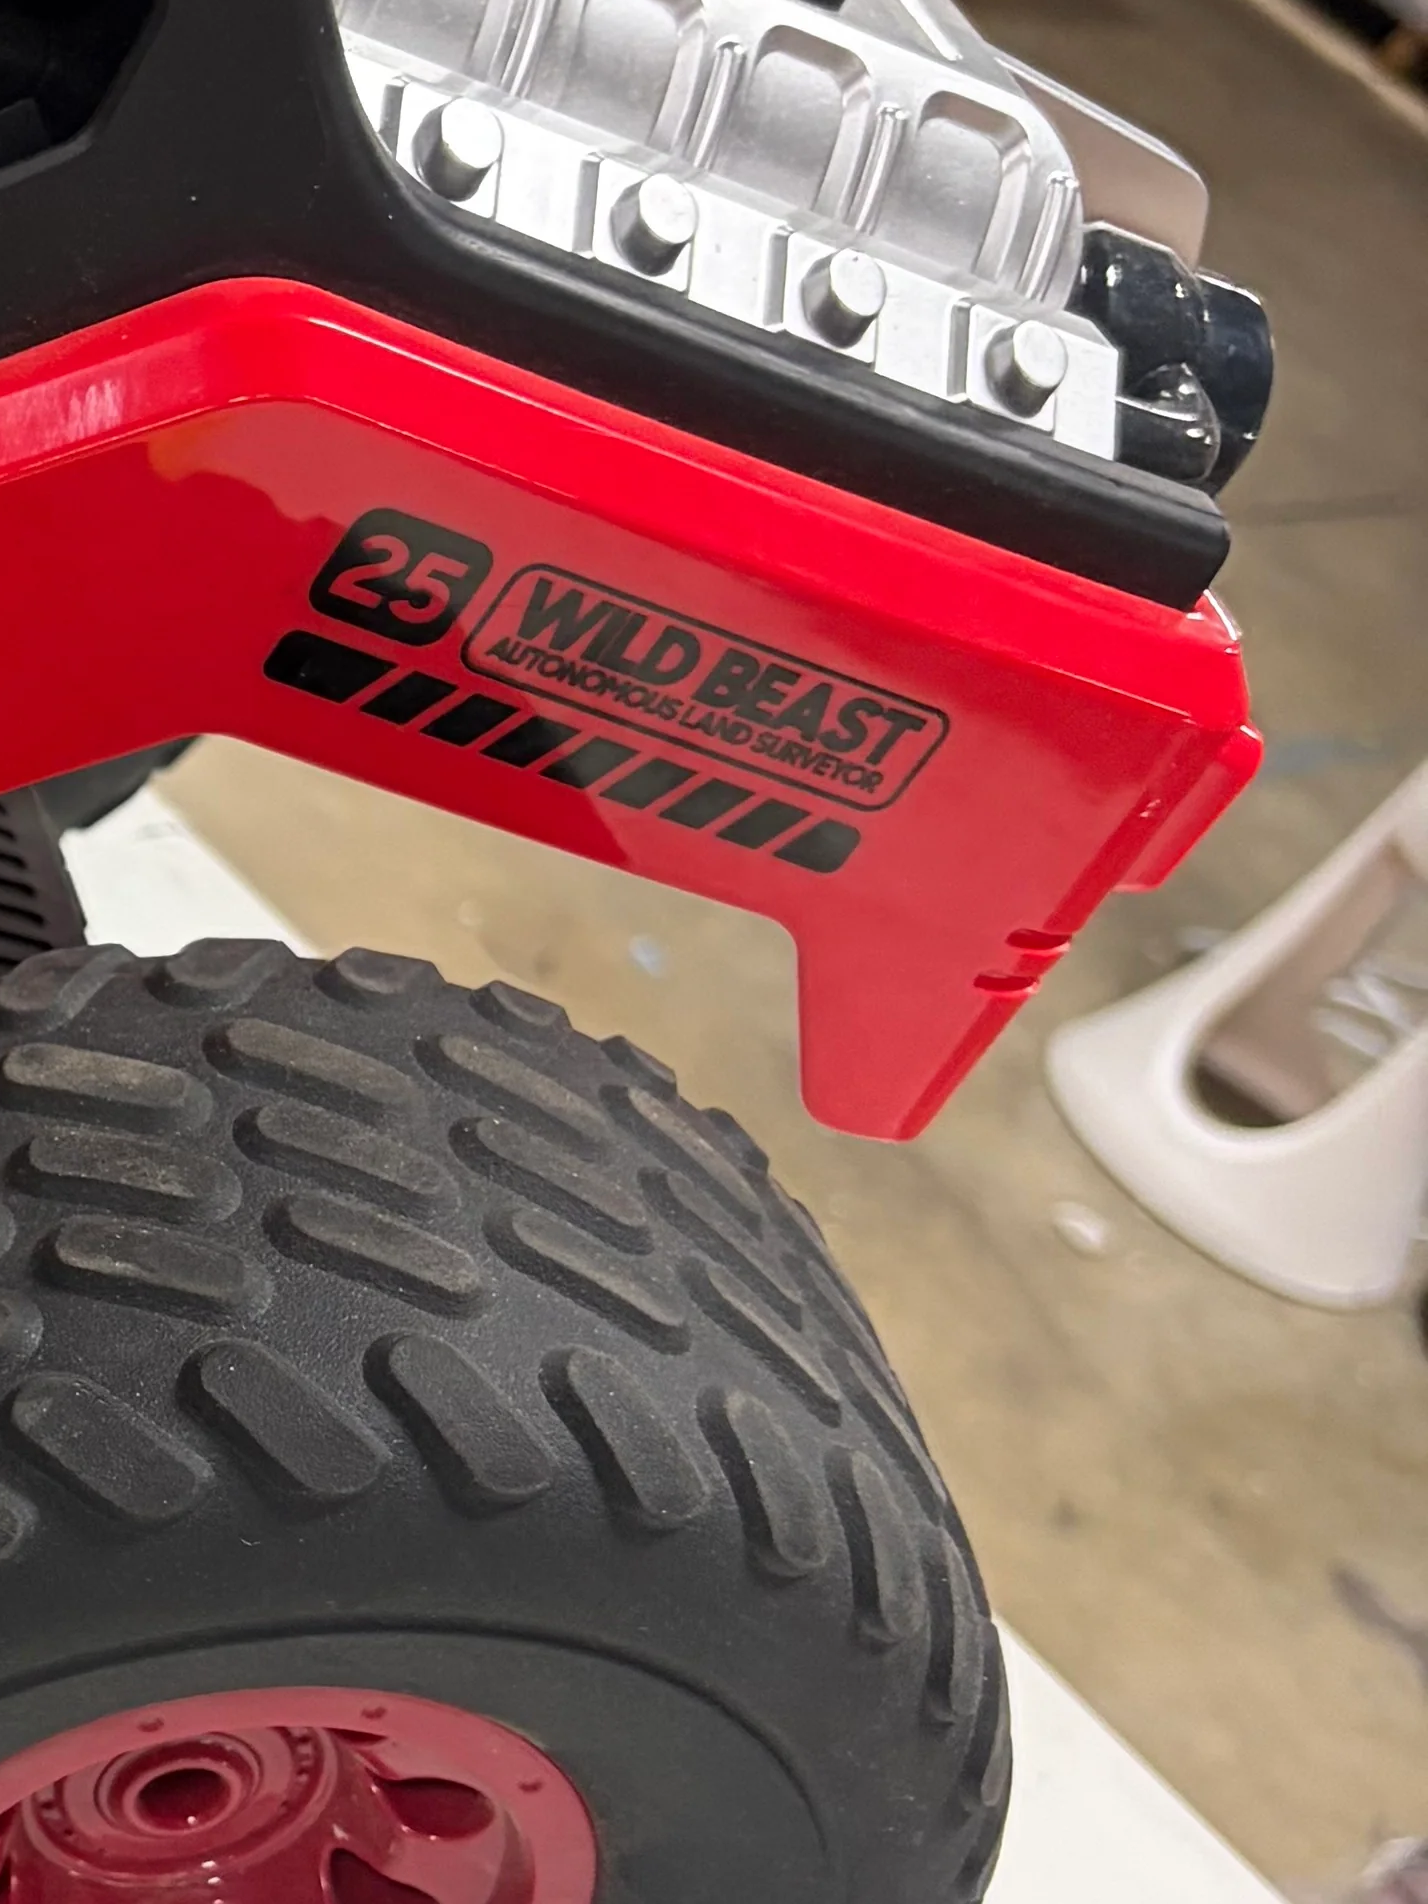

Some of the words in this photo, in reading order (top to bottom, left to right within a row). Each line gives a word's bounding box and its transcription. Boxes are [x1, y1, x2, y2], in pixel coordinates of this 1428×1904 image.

[328, 534, 469, 624] 25
[484, 636, 685, 721] AUTONOMOUS
[679, 705, 753, 746] LAND
[750, 732, 885, 795] SURVEYOR
[516, 576, 701, 686] WILD
[691, 647, 928, 766] BEAST
